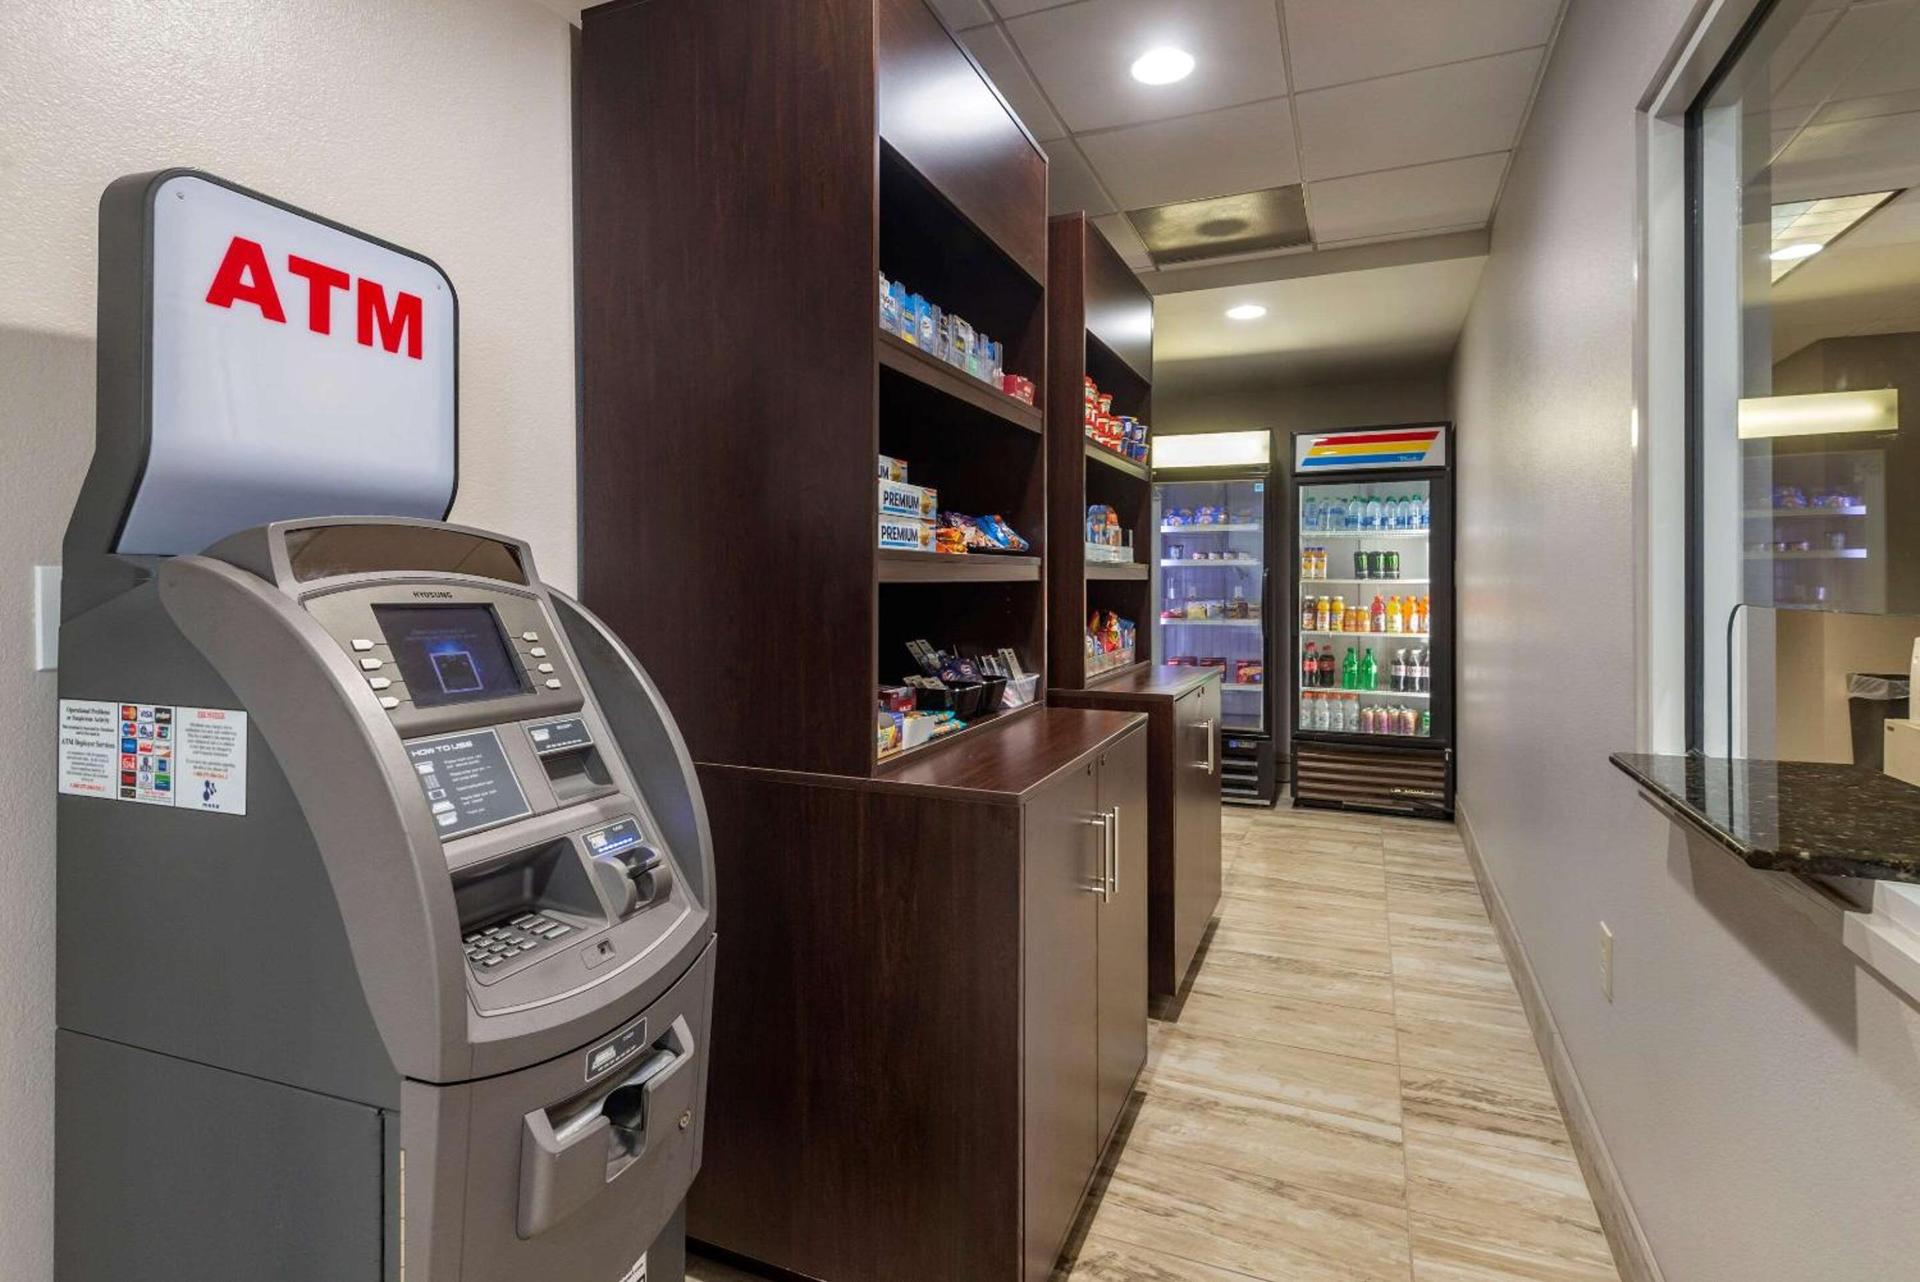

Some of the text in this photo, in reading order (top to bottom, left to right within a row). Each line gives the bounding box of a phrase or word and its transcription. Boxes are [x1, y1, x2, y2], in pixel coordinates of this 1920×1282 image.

[206, 236, 422, 360] ATM
[883, 490, 919, 508] PREMIUM
[881, 526, 919, 542] PREMIUM
[413, 591, 453, 599] HYOSUNG
[411, 740, 473, 757] HOW TO USE
